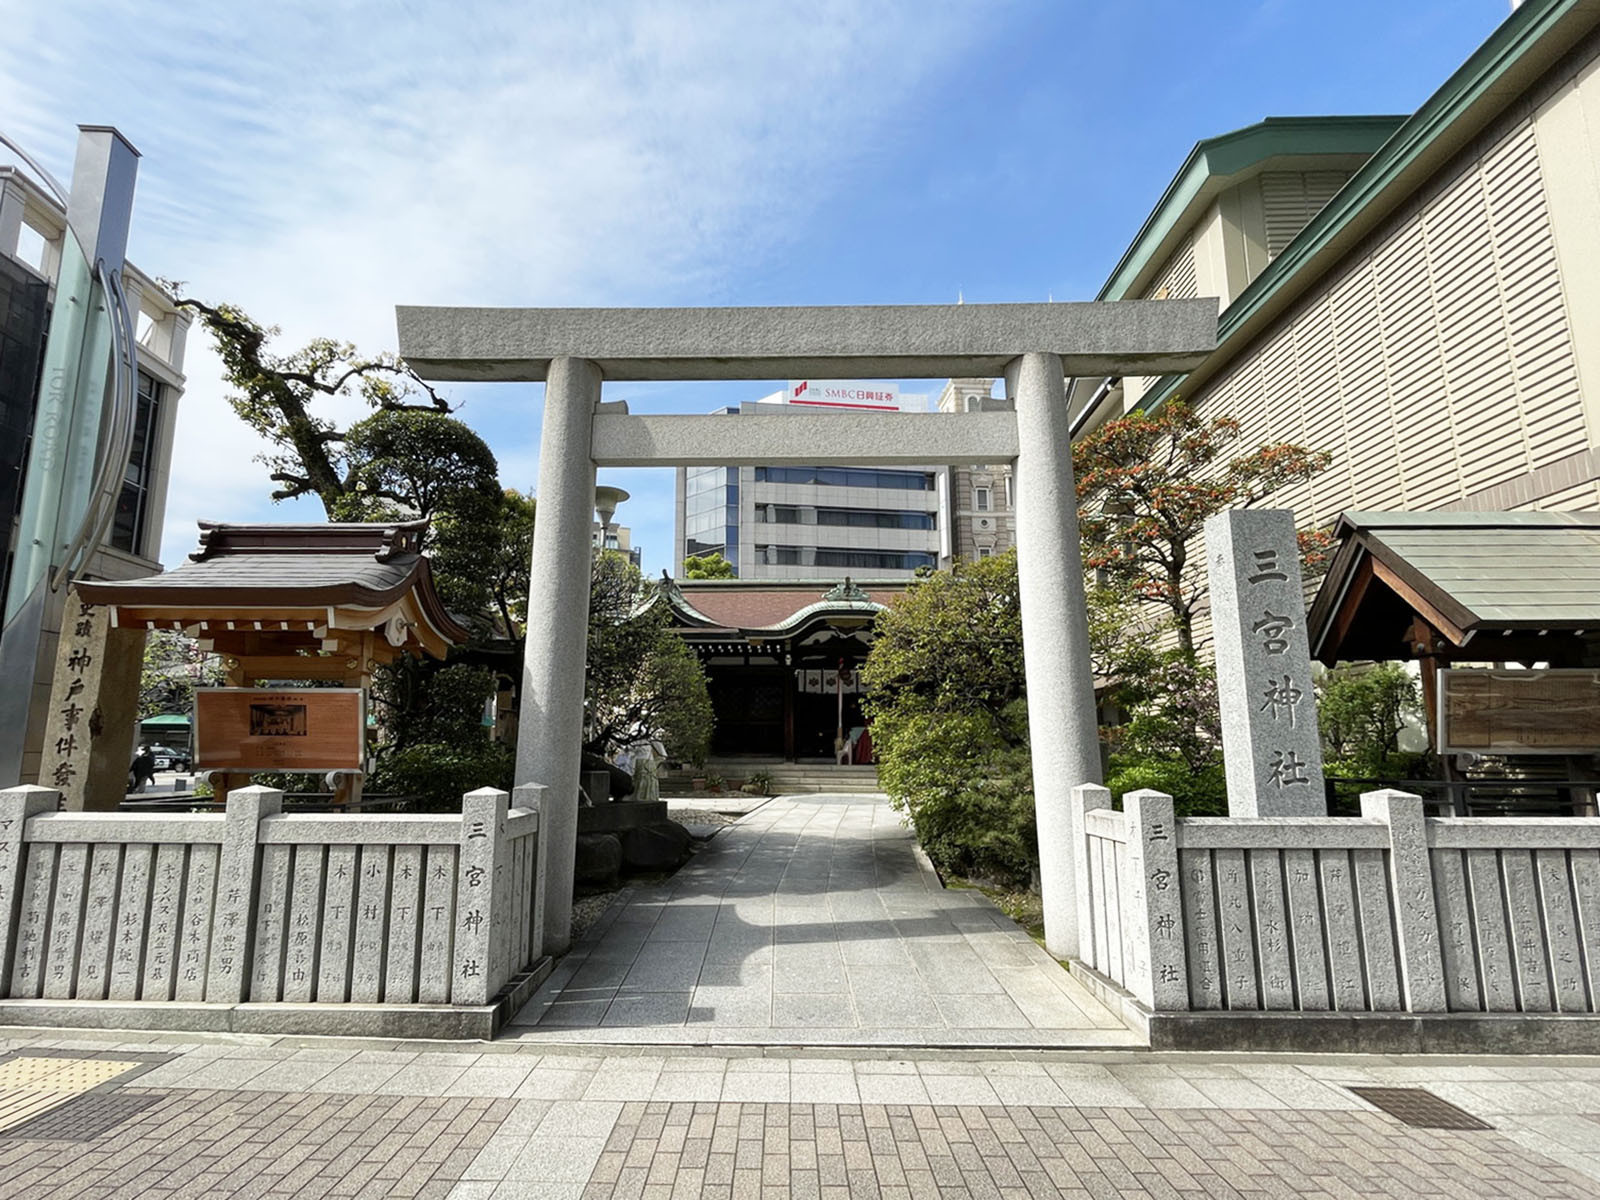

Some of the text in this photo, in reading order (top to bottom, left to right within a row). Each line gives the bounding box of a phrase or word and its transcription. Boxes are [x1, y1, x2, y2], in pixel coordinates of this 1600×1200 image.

[825, 387, 894, 402] SMBC日興証券
[1247, 549, 1311, 790] 三宮神社
[461, 822, 487, 979] 三宮神社
[1149, 823, 1180, 984] 三宮神社
